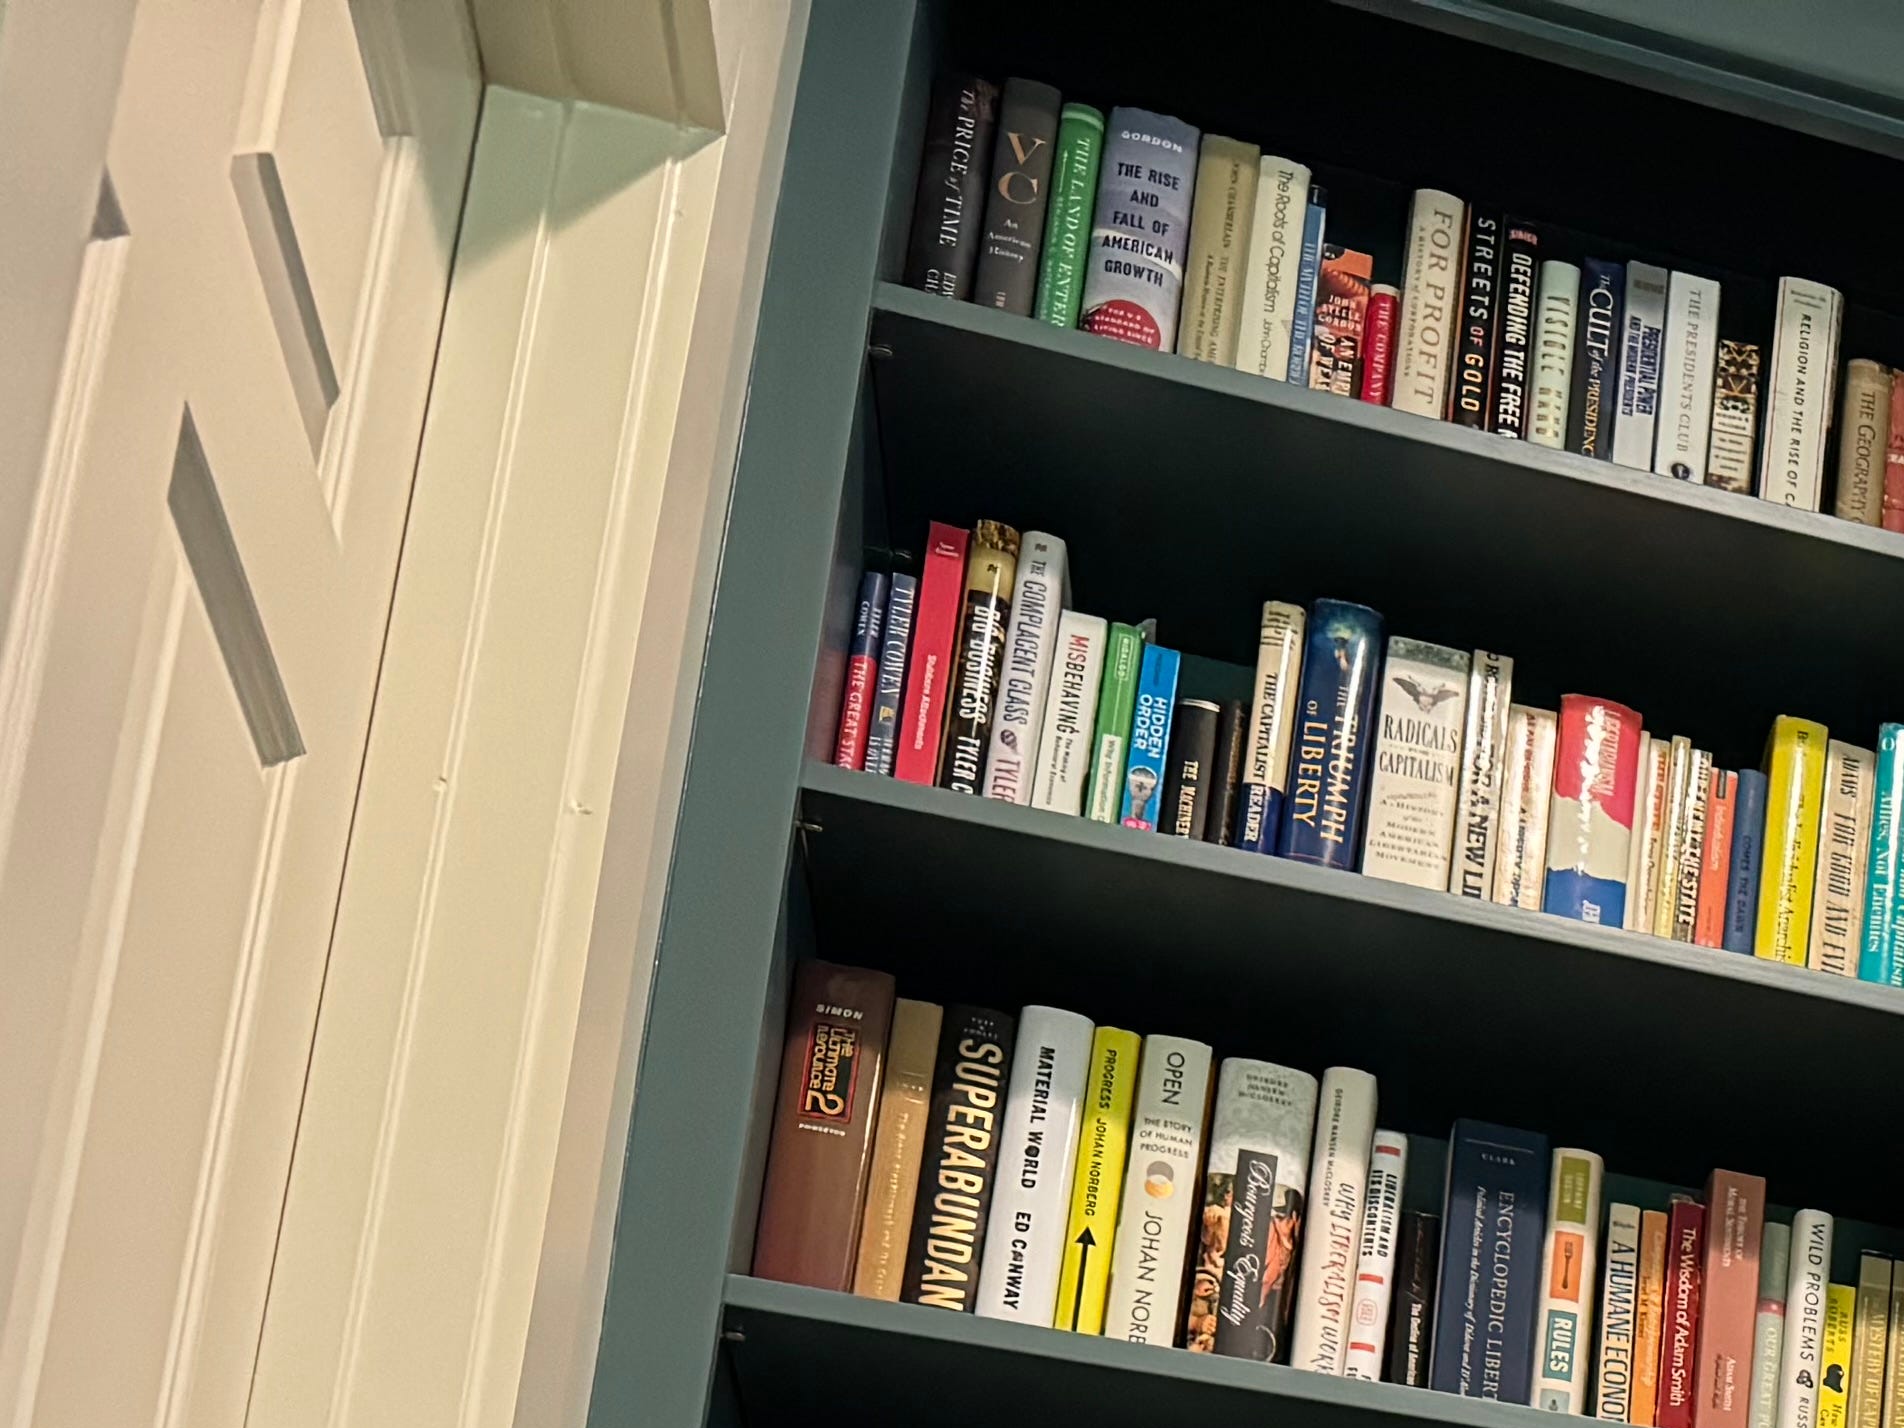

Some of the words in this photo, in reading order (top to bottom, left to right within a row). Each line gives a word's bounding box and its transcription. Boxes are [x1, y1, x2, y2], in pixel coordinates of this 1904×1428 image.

[1117, 163, 1143, 179] THE
[1148, 170, 1180, 191] RISE
[1130, 190, 1160, 208] AND
[1101, 235, 1174, 265] AMERICAN
[1113, 210, 1146, 230] FALL
[1151, 218, 1170, 237] OF
[1429, 208, 1454, 271] FOR
[1104, 259, 1164, 288] GROWTH
[1469, 217, 1496, 320] STREETS
[1414, 279, 1446, 406] PROFIT
[1470, 326, 1484, 347] OF
[1460, 352, 1485, 413] GOLD
[1054, 635, 1091, 735] MISBEHAVING
[1133, 692, 1154, 751] ORDER
[1147, 697, 1168, 758] HIDDEN
[816, 1003, 864, 1021] SIMON
[1030, 1045, 1056, 1124] MATERIAL
[1162, 1051, 1185, 1106] OPEN
[1020, 1130, 1042, 1189] WORLD
[1092, 1120, 1108, 1162] JOHAN
[1085, 1165, 1102, 1218] NORBERG
[1014, 1211, 1031, 1236] ED
[1806, 1223, 1827, 1266] WILD
[1002, 1239, 1026, 1311] CONWAY
[1547, 1316, 1573, 1373] RULES
[1799, 1272, 1823, 1361] PROBLEMS
